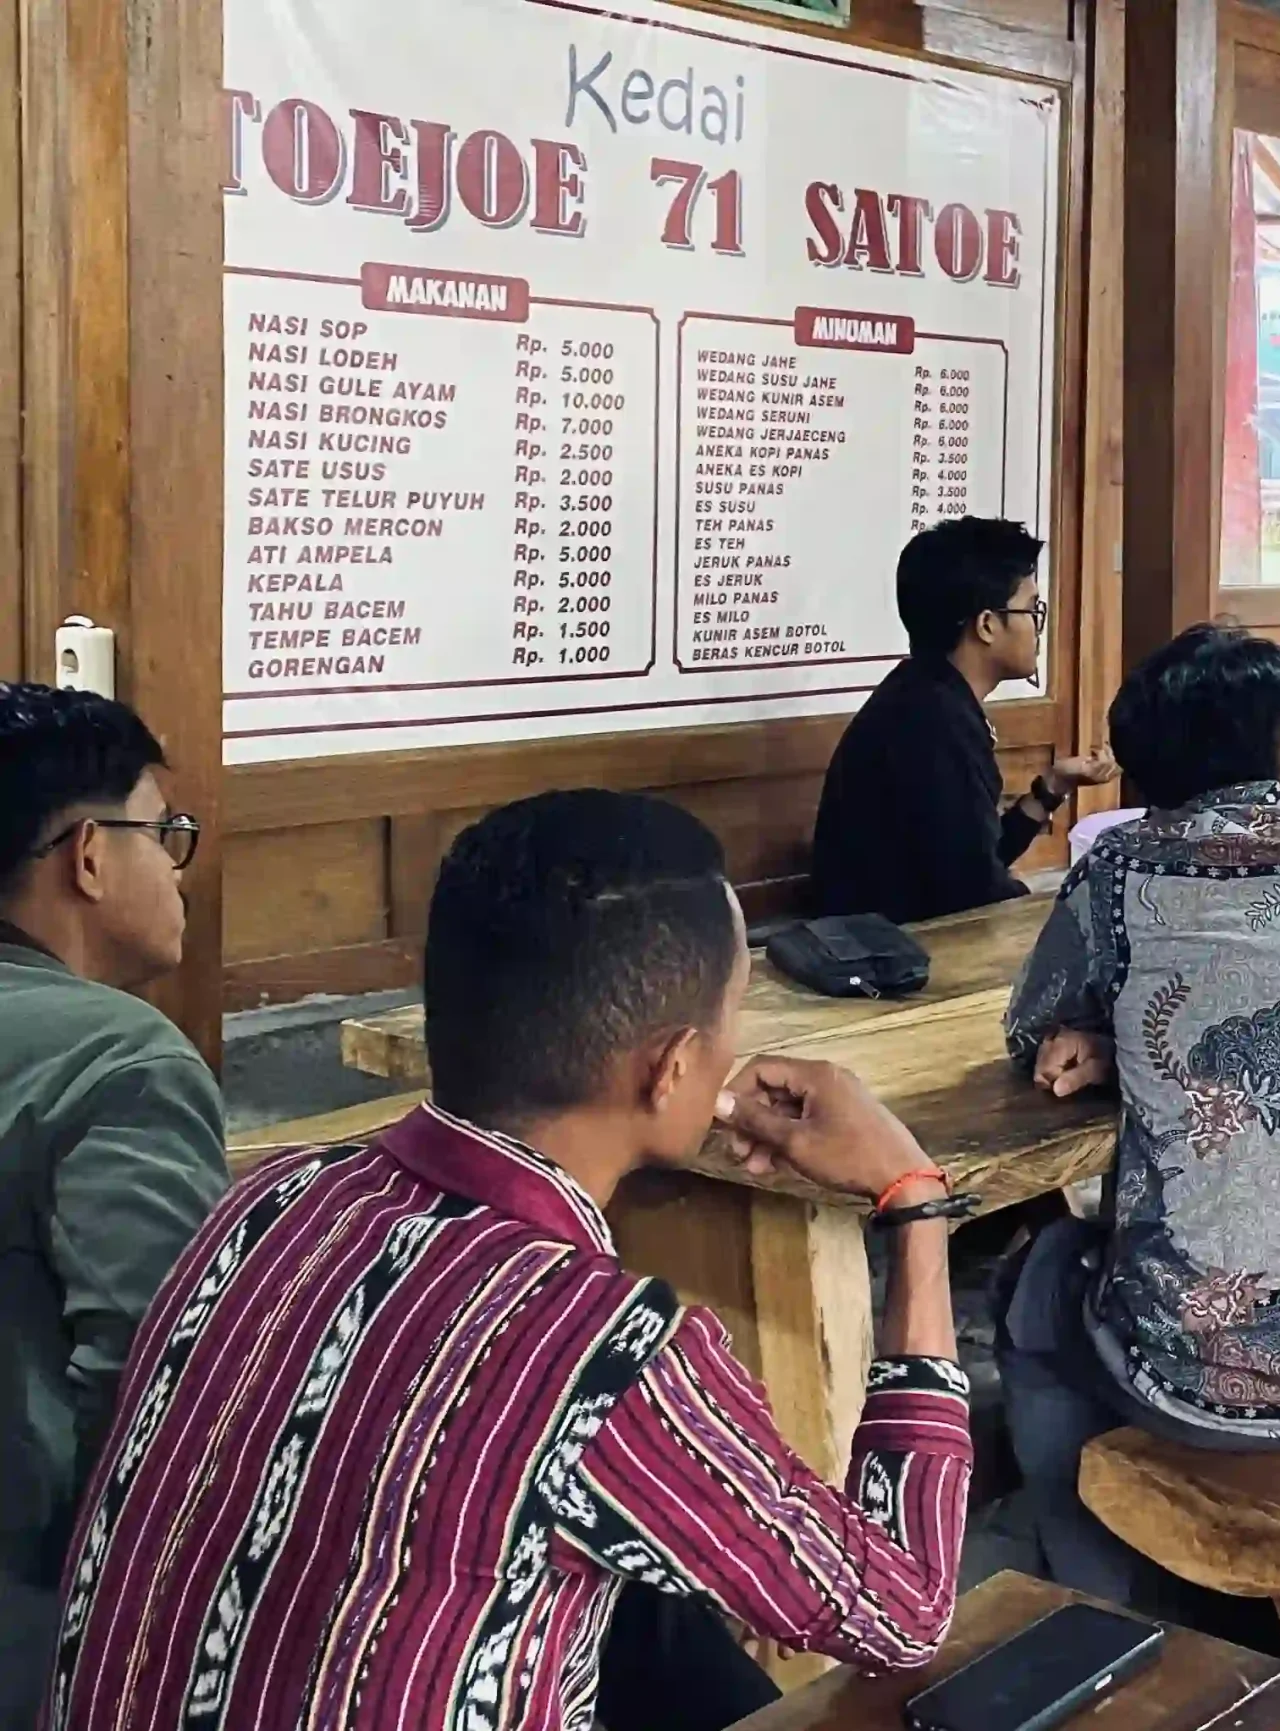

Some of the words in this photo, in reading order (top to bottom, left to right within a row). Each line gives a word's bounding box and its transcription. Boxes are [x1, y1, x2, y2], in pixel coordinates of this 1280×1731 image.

[565, 43, 745, 145] Kedai
[651, 157, 745, 257] 71
[805, 181, 1024, 290] SATOE
[386, 275, 507, 312] MAKANAN
[248, 313, 308, 335] NASI
[319, 319, 368, 340] SOP
[248, 342, 308, 364] NASI
[318, 348, 398, 371] LODEH
[516, 333, 547, 355] Rp.
[561, 340, 614, 359] 5.000
[697, 350, 756, 366] WEDANG
[762, 355, 797, 369] JAHE
[515, 360, 547, 382] Rp.
[560, 366, 614, 384] 5.000
[697, 368, 755, 384] WEDANG
[761, 373, 798, 387] SUSU
[802, 377, 837, 390] JAHE
[248, 371, 308, 393] NASI
[318, 375, 383, 397] GULE
[392, 381, 456, 402] AYAM
[515, 386, 547, 408] Rp.
[562, 392, 625, 410] 10.000
[696, 387, 755, 403] WEDANG
[762, 391, 804, 406] KUNIR
[809, 395, 845, 408] ASEM
[247, 400, 307, 422] NASI
[319, 404, 448, 429] BRONGKOS
[515, 412, 546, 434] Rp.
[561, 418, 613, 435] 7.000
[696, 406, 755, 422] WEDANG
[761, 410, 810, 424] SERUNI
[248, 429, 307, 450] NASI
[318, 432, 411, 454] KUCING
[696, 425, 755, 440] WEDANG
[514, 439, 546, 460] Rp.
[560, 443, 613, 461] 2.500
[695, 444, 743, 457] ANEKA
[750, 446, 781, 458] KOPI
[785, 447, 830, 460] PANAS
[247, 458, 310, 479] SATE
[321, 460, 387, 481] USUS
[514, 465, 546, 486] Rp.
[560, 469, 613, 486] 2.000
[695, 463, 743, 476] ANEKA
[749, 464, 766, 477] ES
[772, 465, 803, 478] KOPI
[247, 487, 310, 507] SATE
[321, 489, 396, 509] TELUR
[406, 491, 485, 510] PUYUH
[695, 481, 733, 494] SUSU
[738, 482, 784, 495] PANAS
[514, 491, 545, 512] Rp.
[559, 495, 613, 512] 3.500
[694, 500, 712, 513] ES
[719, 500, 756, 513] SUSU
[247, 516, 333, 536] BAKSO
[344, 518, 443, 537] MERCON
[514, 517, 545, 538] Rp.
[558, 520, 612, 537] 2.000
[695, 519, 722, 532] TEH
[728, 519, 774, 532] PANAS
[247, 545, 287, 564] ATI
[297, 545, 393, 564] AMPELA
[513, 543, 545, 564] Rp.
[558, 546, 612, 562] 5.000
[694, 538, 712, 550] ES
[719, 538, 745, 550] TEH
[693, 555, 741, 569] JERUK
[745, 555, 792, 568] PANAS
[247, 573, 344, 593] KEPALA
[513, 569, 545, 590] Rp.
[558, 571, 611, 588] 5.000
[694, 574, 711, 587] ES
[717, 573, 763, 587] JERUK
[513, 595, 545, 616] Rp.
[557, 596, 611, 613] 2.000
[693, 593, 727, 606] MILO
[733, 591, 780, 604] PANAS
[248, 601, 313, 621] TAHU
[324, 600, 406, 620] BACEM
[693, 611, 711, 624] ES
[716, 610, 750, 624] MILO
[248, 629, 330, 650] TEMPE
[342, 627, 422, 647] BACEM
[512, 621, 544, 642] Rp.
[559, 621, 610, 639] 1.500
[692, 629, 738, 643] KUNIR
[742, 626, 781, 641] ASEM
[785, 624, 828, 638] BOTOL
[512, 647, 544, 667] Rp.
[558, 646, 610, 664] 1.000
[692, 647, 738, 661] BERAS
[744, 643, 799, 658] KENCUR
[804, 641, 846, 654] BOTOL
[248, 655, 385, 679] GORENGAN
